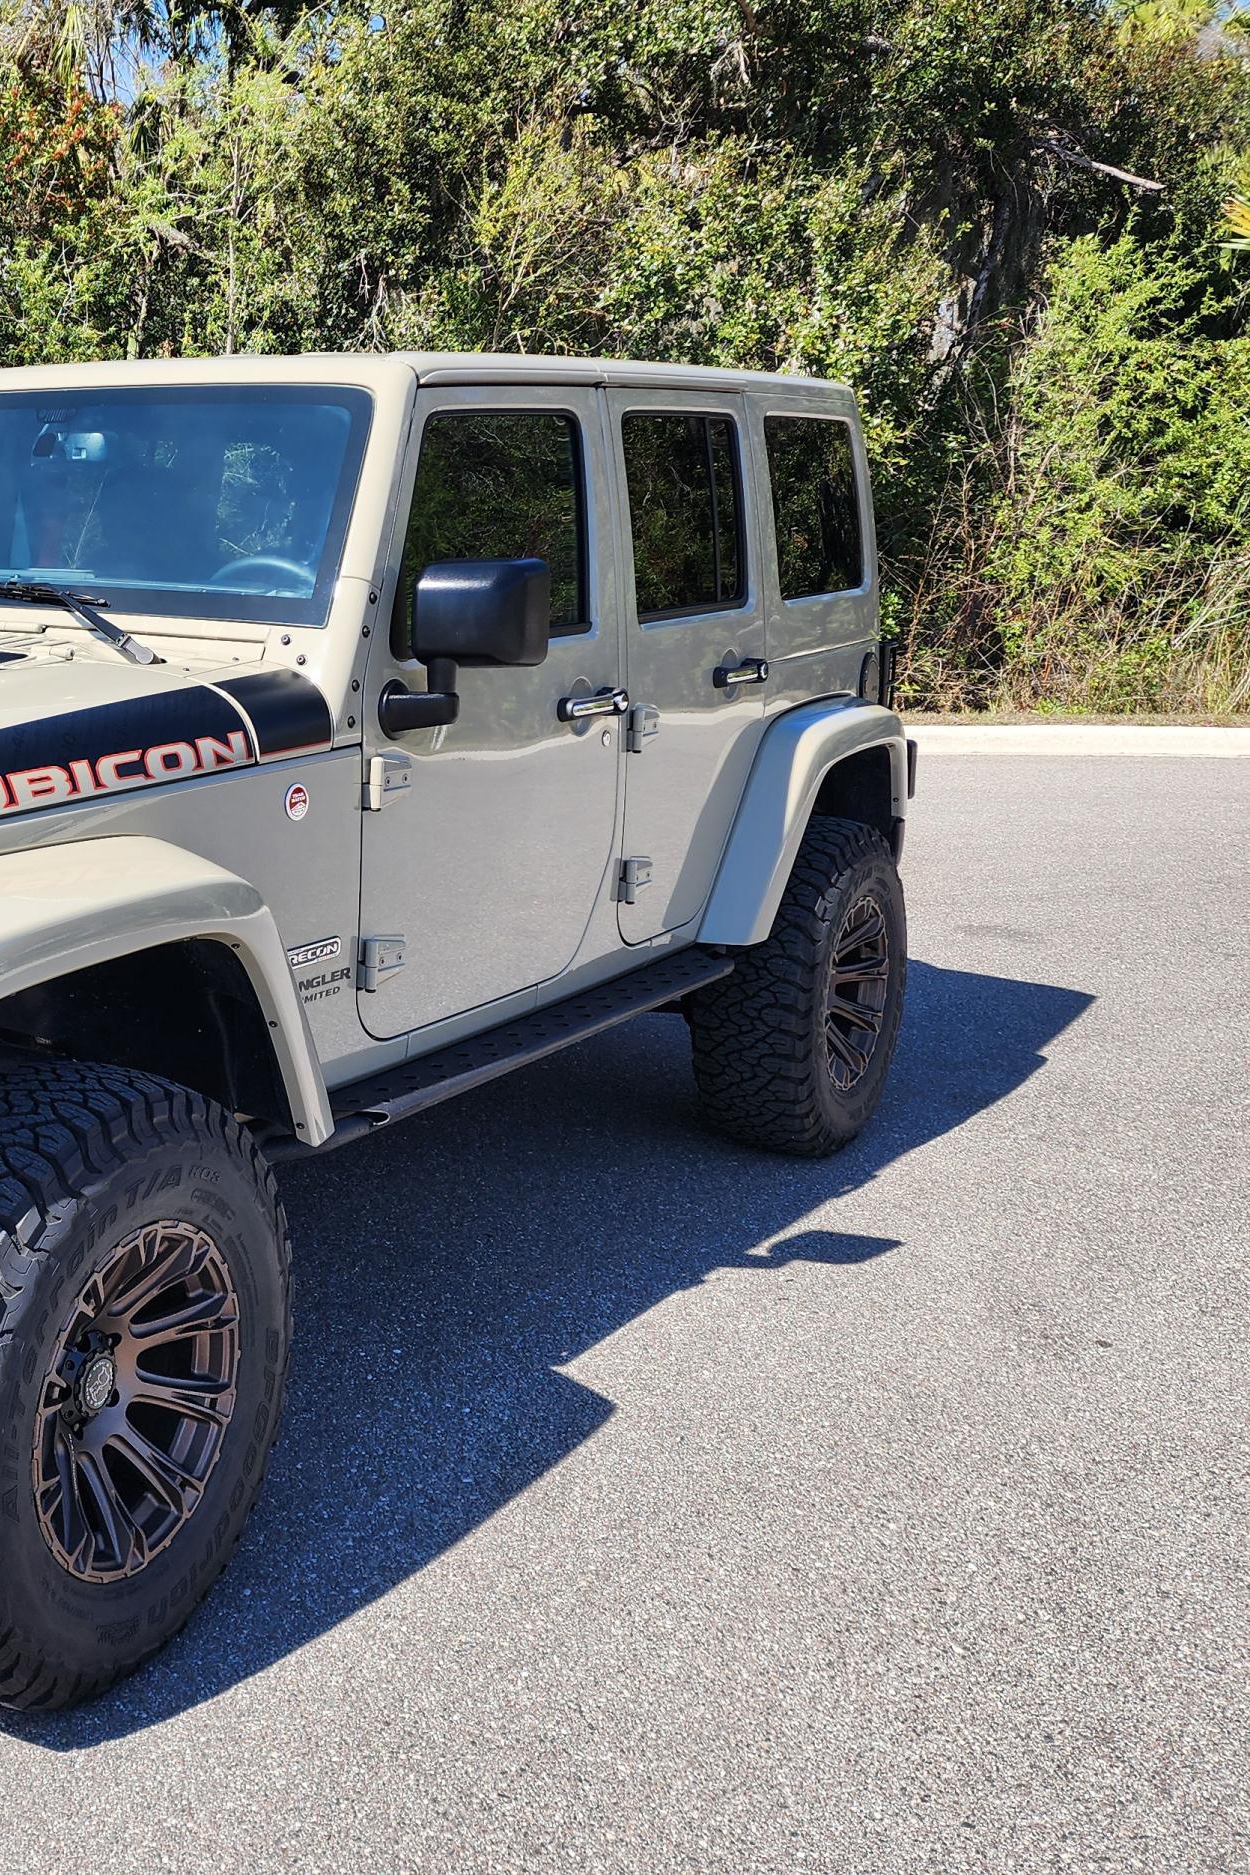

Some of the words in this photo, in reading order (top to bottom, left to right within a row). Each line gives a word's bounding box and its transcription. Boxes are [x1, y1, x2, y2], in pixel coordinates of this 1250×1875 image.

[289, 943, 338, 964] RECON
[298, 967, 351, 992] NGLER
[302, 986, 341, 1004] MITED
